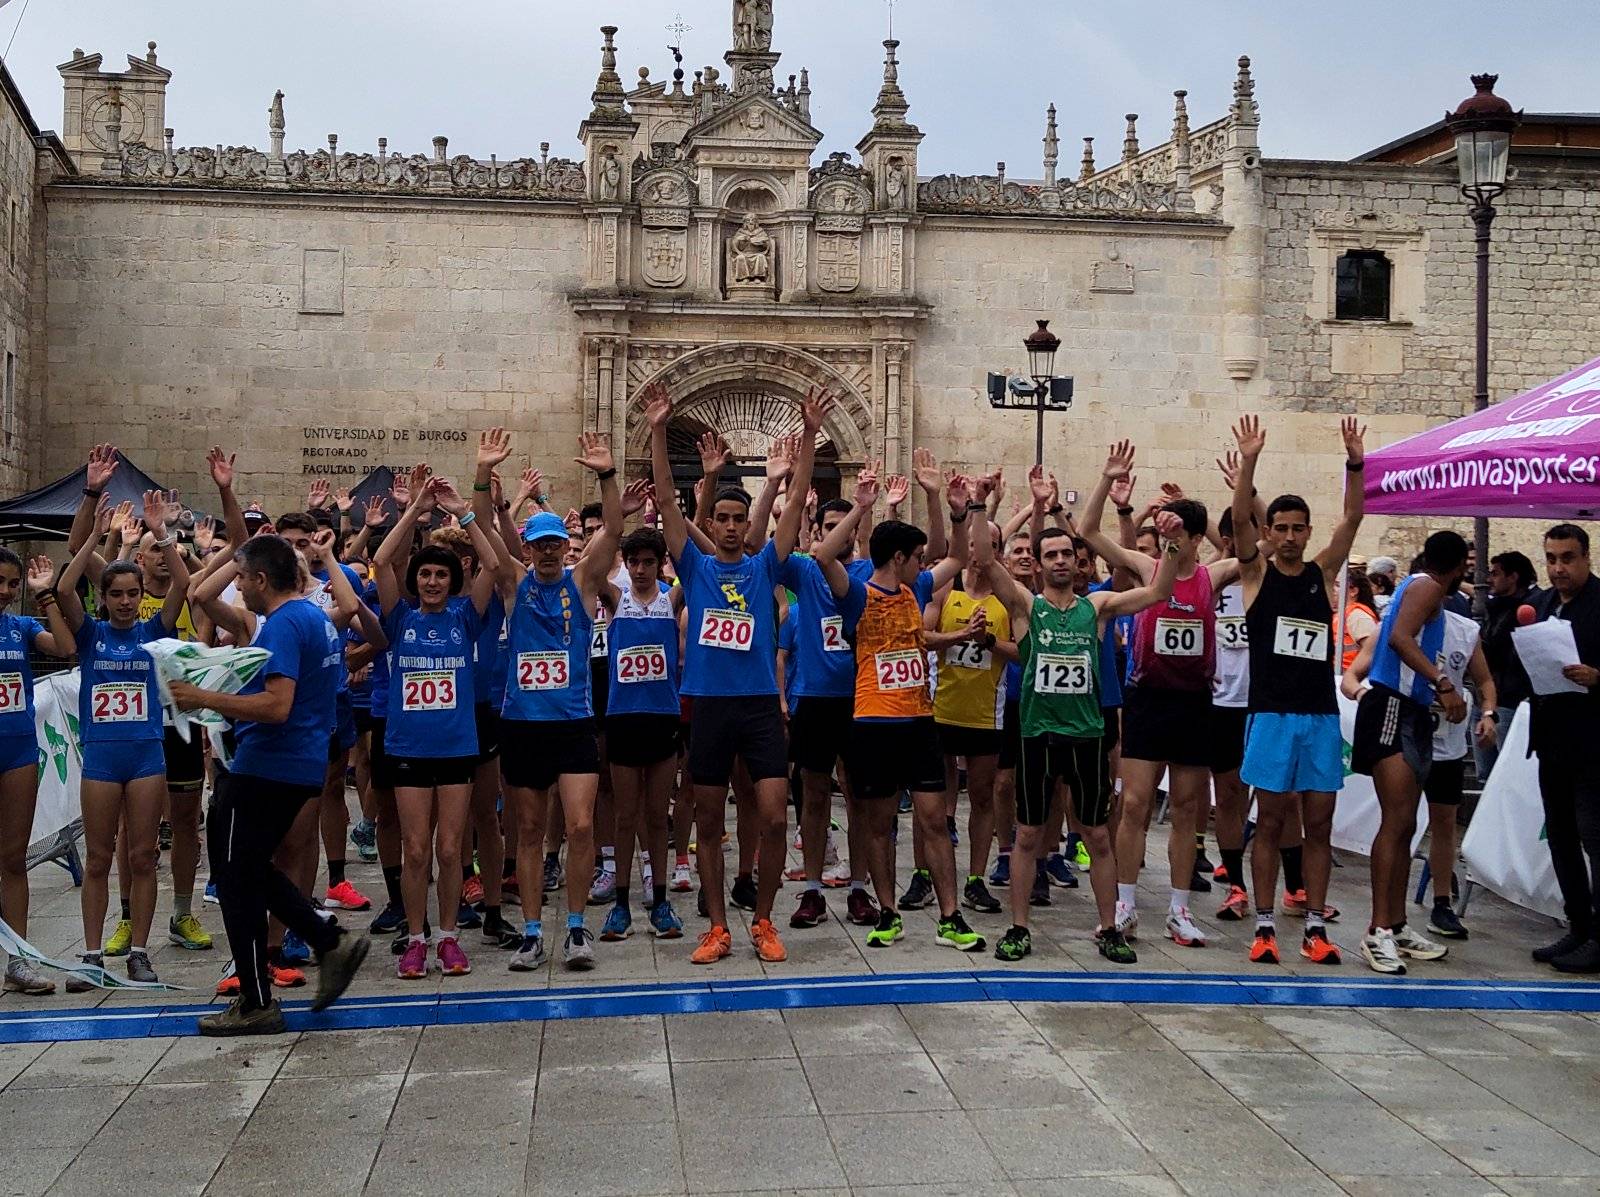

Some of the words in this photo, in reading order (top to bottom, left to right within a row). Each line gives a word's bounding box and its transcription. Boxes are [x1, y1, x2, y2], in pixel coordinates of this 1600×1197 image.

[303, 427, 386, 441] UNIVERSIDAD
[392, 429, 410, 441] DE
[418, 430, 468, 442] BURGOS
[302, 447, 368, 458] RECTORADO
[302, 464, 356, 475] FACULTAD
[1380, 453, 1600, 495] www.runvasport.es
[702, 617, 751, 645] 280
[1164, 628, 1195, 650] 60
[1288, 628, 1318, 653] 17
[956, 640, 983, 664] 73
[520, 660, 567, 685] 233
[619, 653, 665, 678] 299
[880, 658, 923, 685] 290
[1039, 663, 1086, 689] 123
[94, 691, 143, 717] 231
[405, 679, 454, 705] 203
